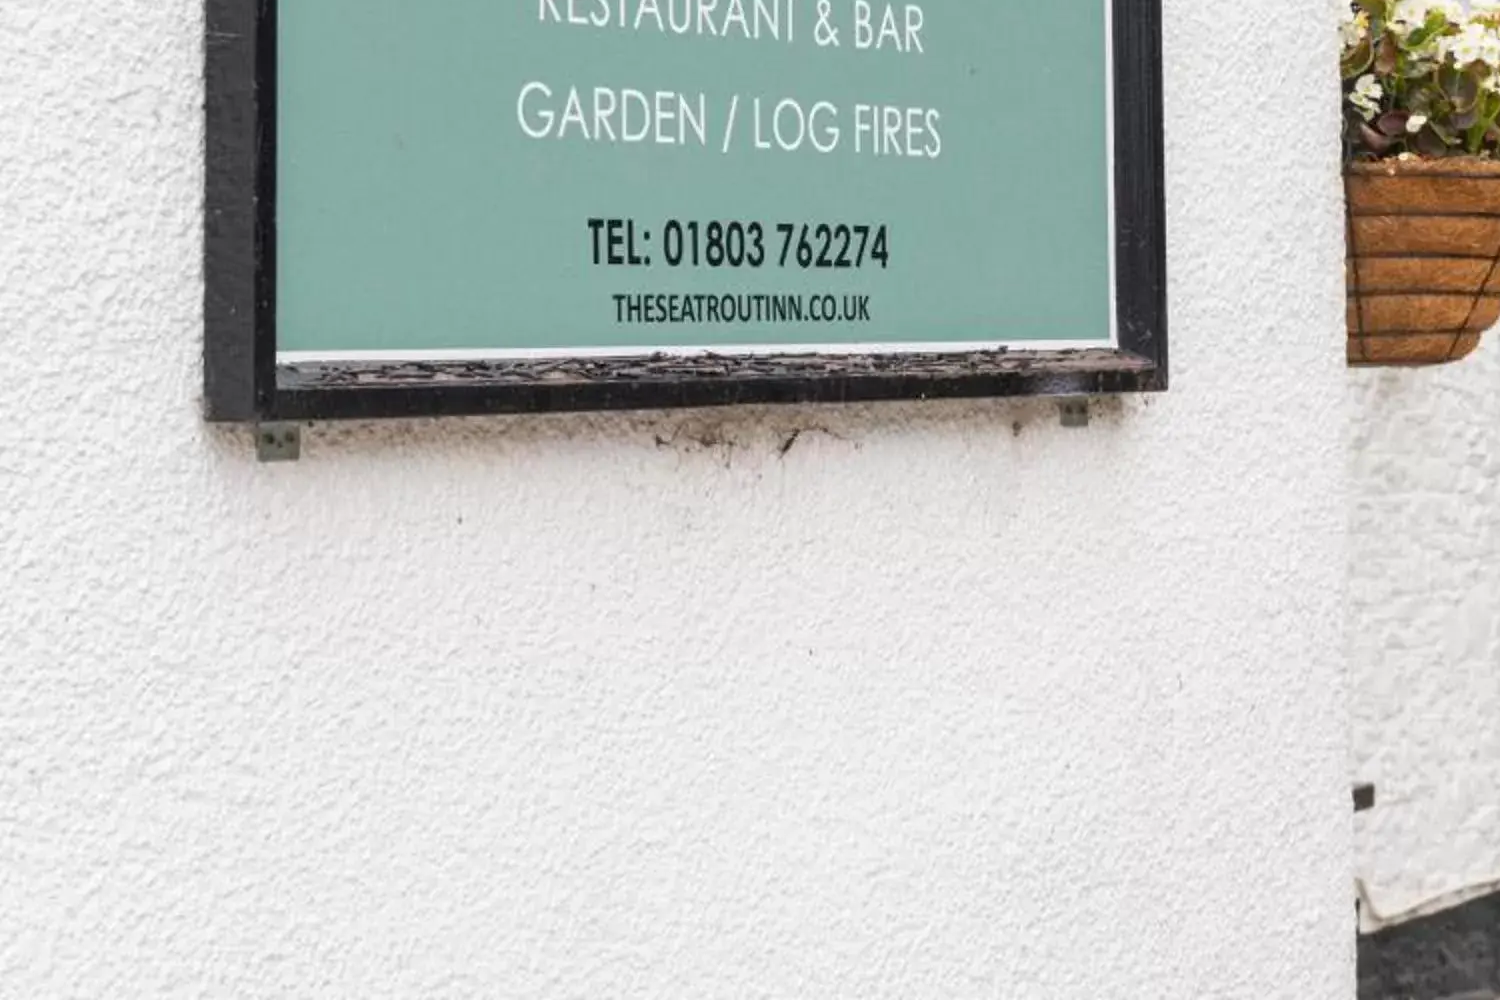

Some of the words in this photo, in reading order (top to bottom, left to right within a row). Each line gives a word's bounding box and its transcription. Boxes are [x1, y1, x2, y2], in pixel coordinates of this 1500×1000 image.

[854, 0, 924, 52] BAR
[517, 81, 706, 145] GARDEN
[723, 95, 741, 152] /
[754, 97, 840, 153] LOG
[854, 103, 942, 158] FIRES
[588, 218, 652, 266] TEL:
[663, 221, 765, 267] 01803
[776, 224, 889, 269] 762274
[612, 293, 871, 324] THESEATROUTINN.CO.UK
